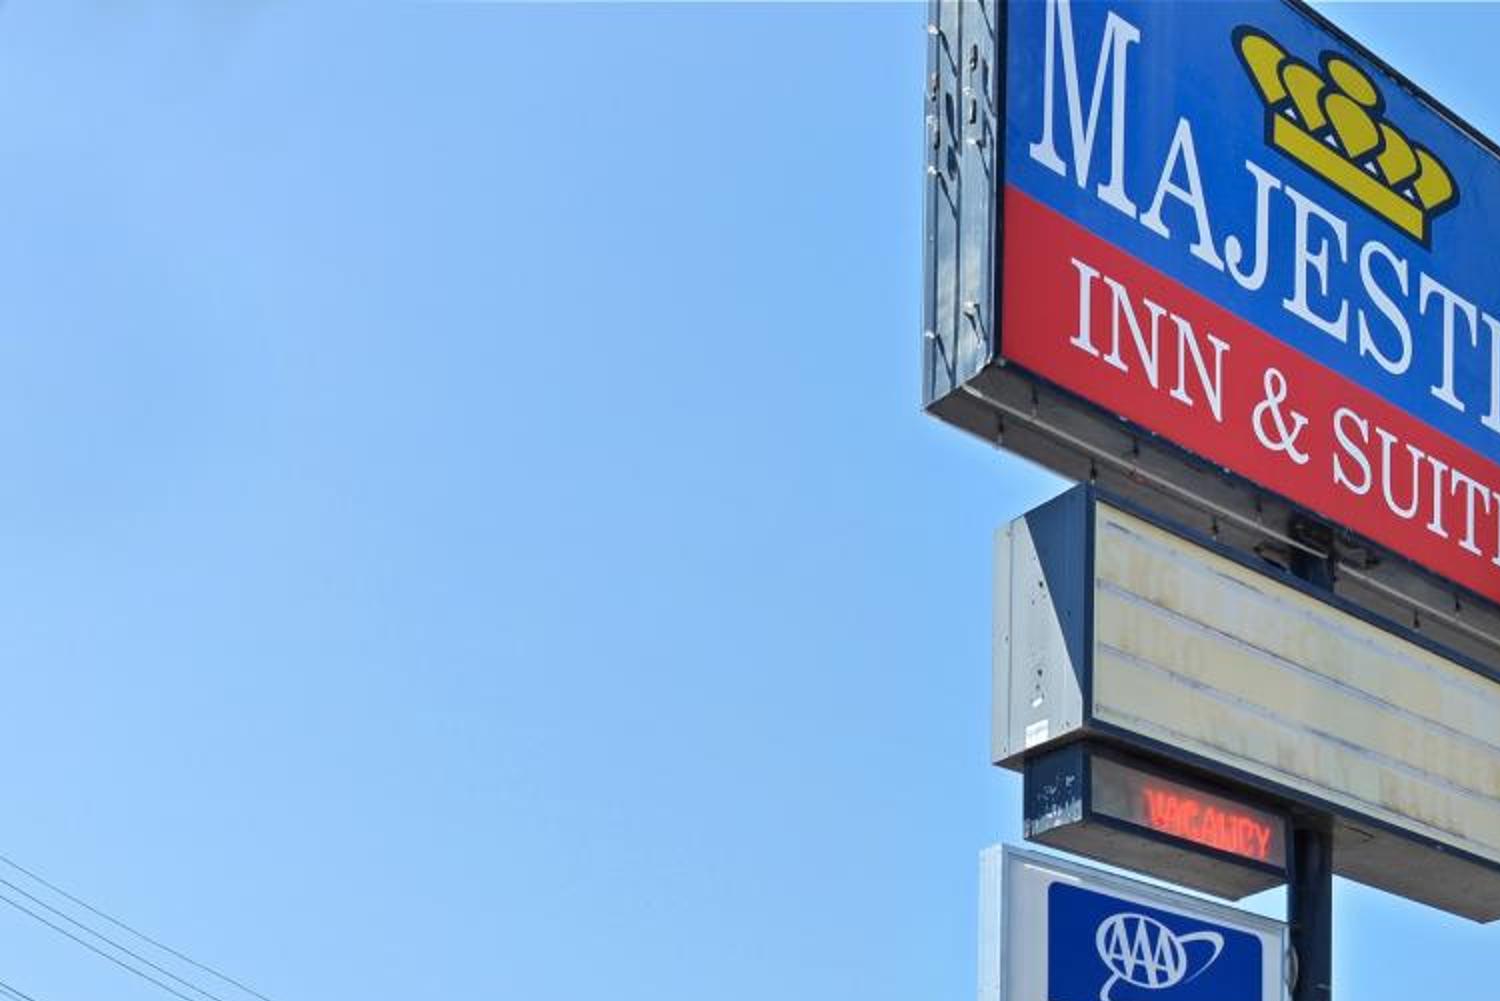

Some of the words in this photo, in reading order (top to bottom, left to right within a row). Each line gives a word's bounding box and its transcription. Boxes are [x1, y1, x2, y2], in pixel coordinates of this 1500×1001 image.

[1070, 257, 1230, 423] INN
[1251, 367, 1310, 465] &
[1104, 916, 1181, 986] AAA
